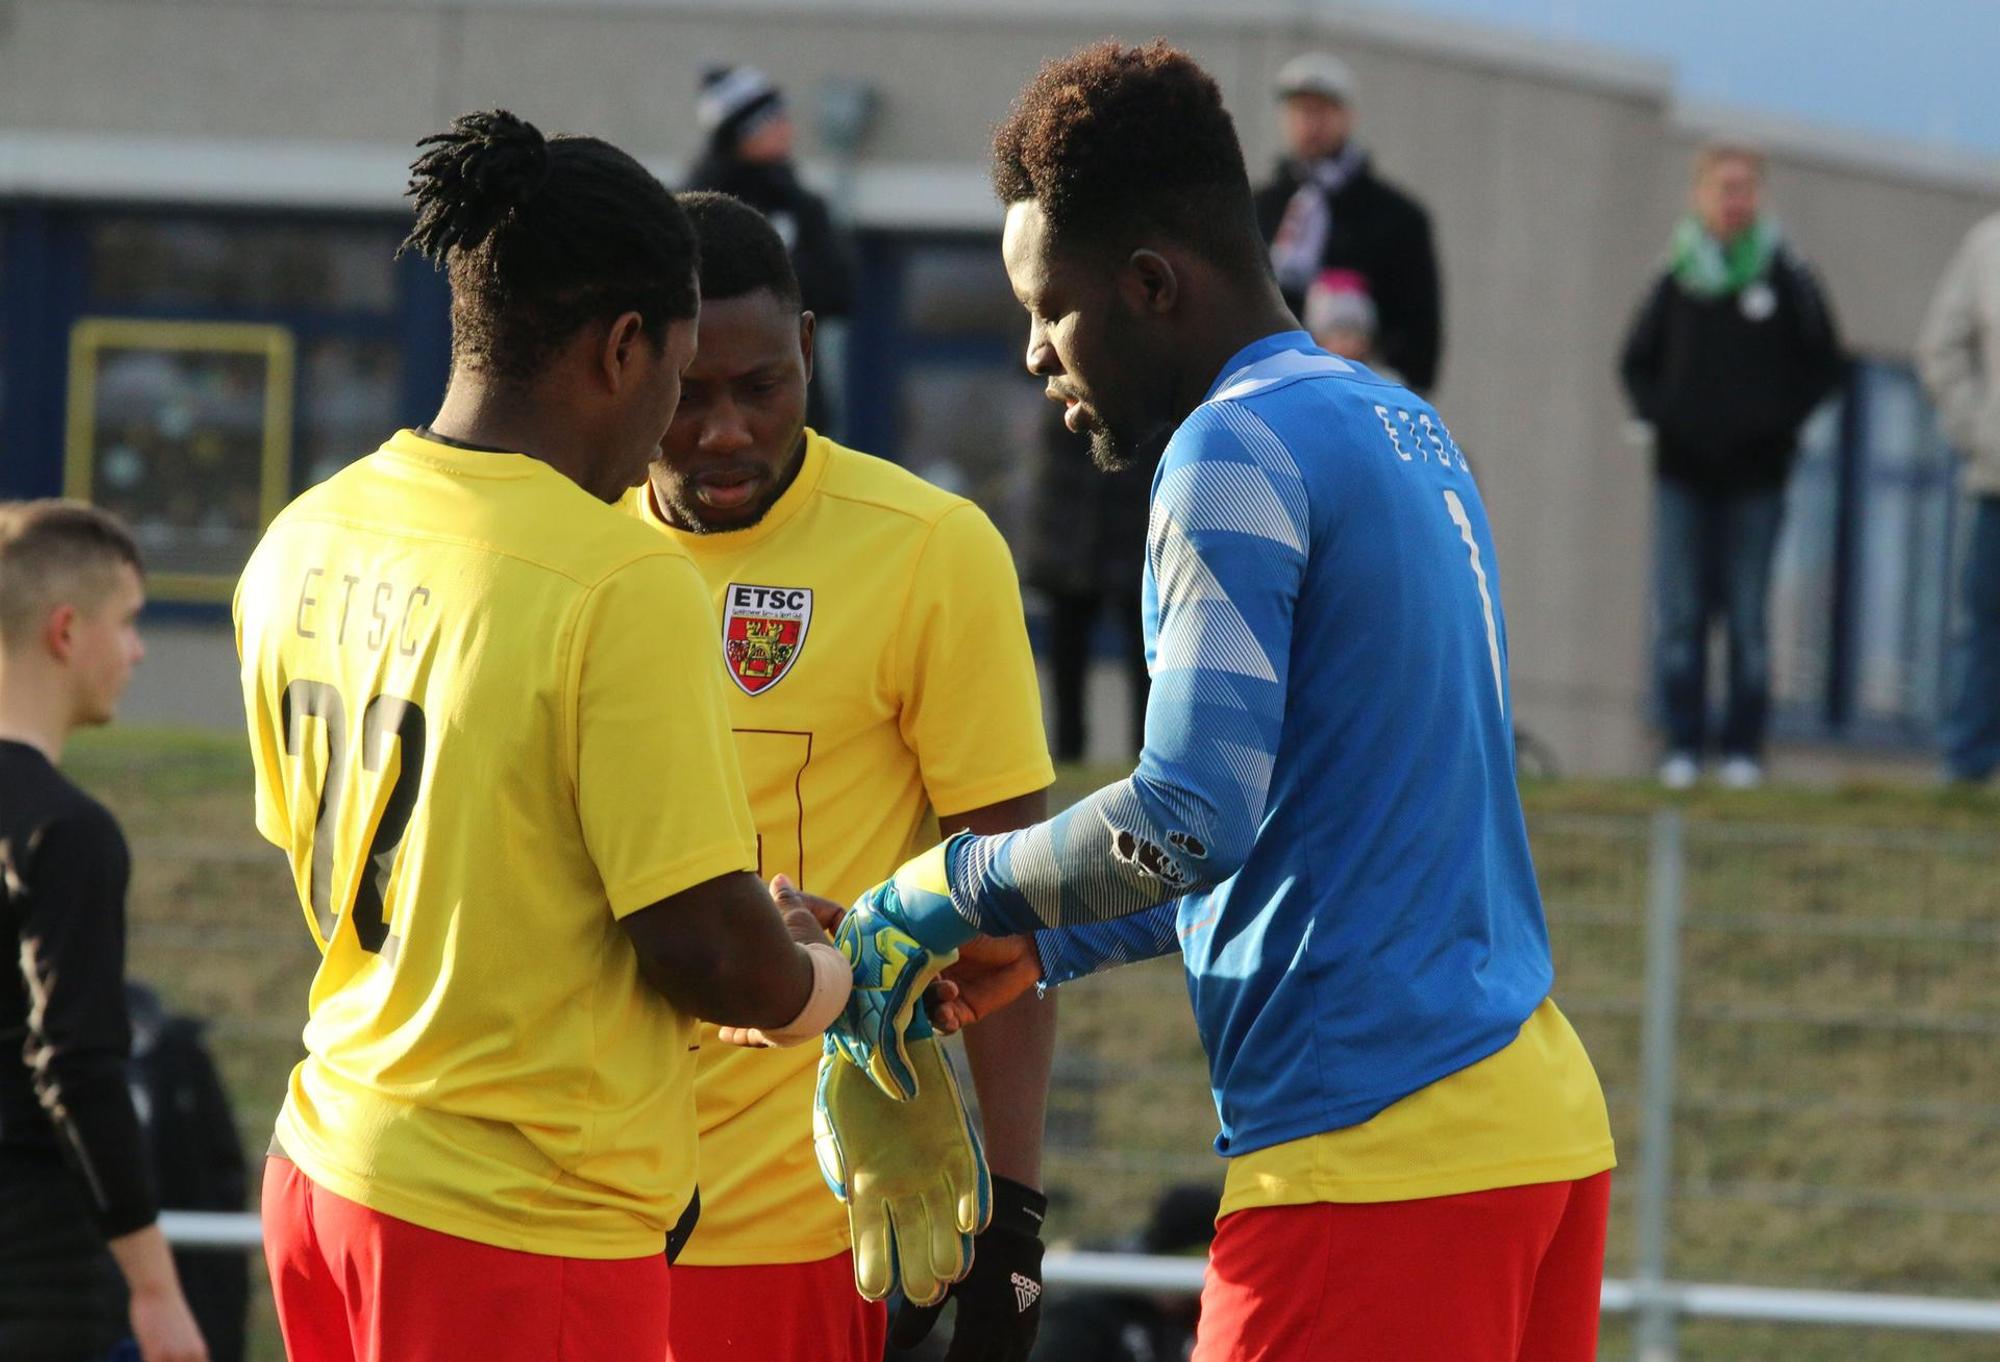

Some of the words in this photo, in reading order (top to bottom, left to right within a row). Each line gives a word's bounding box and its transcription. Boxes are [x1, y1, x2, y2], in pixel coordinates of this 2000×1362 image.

[296, 568, 429, 657] ETSC
[734, 587, 805, 611] ETSC
[1443, 490, 1504, 721] 1
